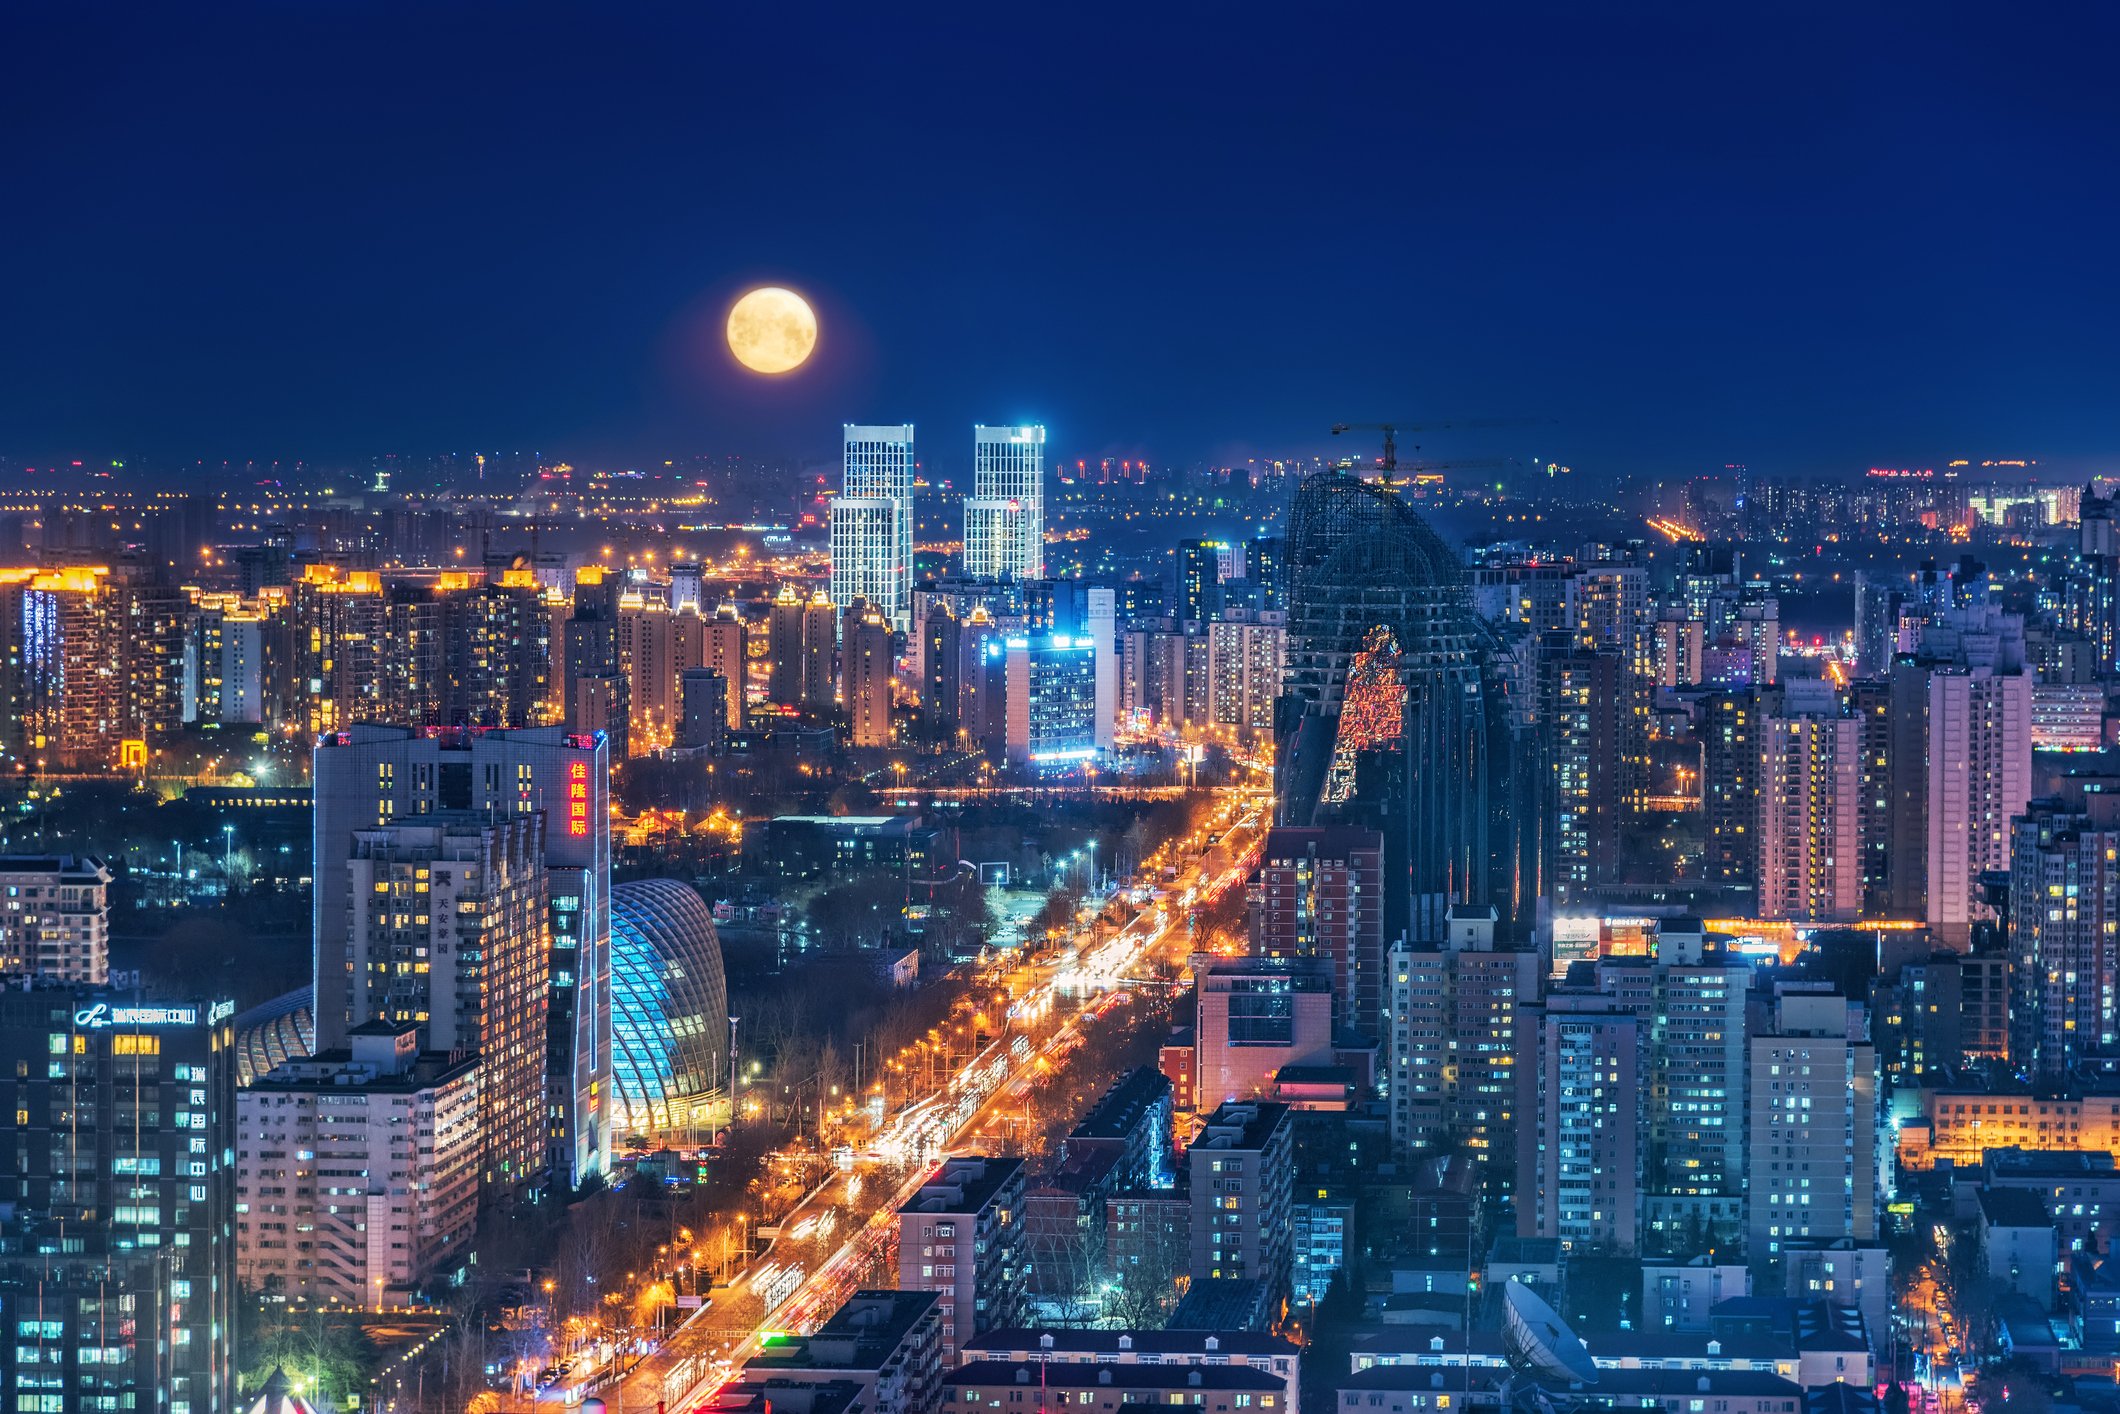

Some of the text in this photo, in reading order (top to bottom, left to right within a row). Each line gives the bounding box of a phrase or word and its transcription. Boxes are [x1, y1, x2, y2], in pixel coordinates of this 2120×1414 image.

[571, 763, 586, 835] 佳隆国际
[111, 1008, 196, 1025] 瑞辰国际中心
[190, 1066, 206, 1202] 瑞辰国际中心
